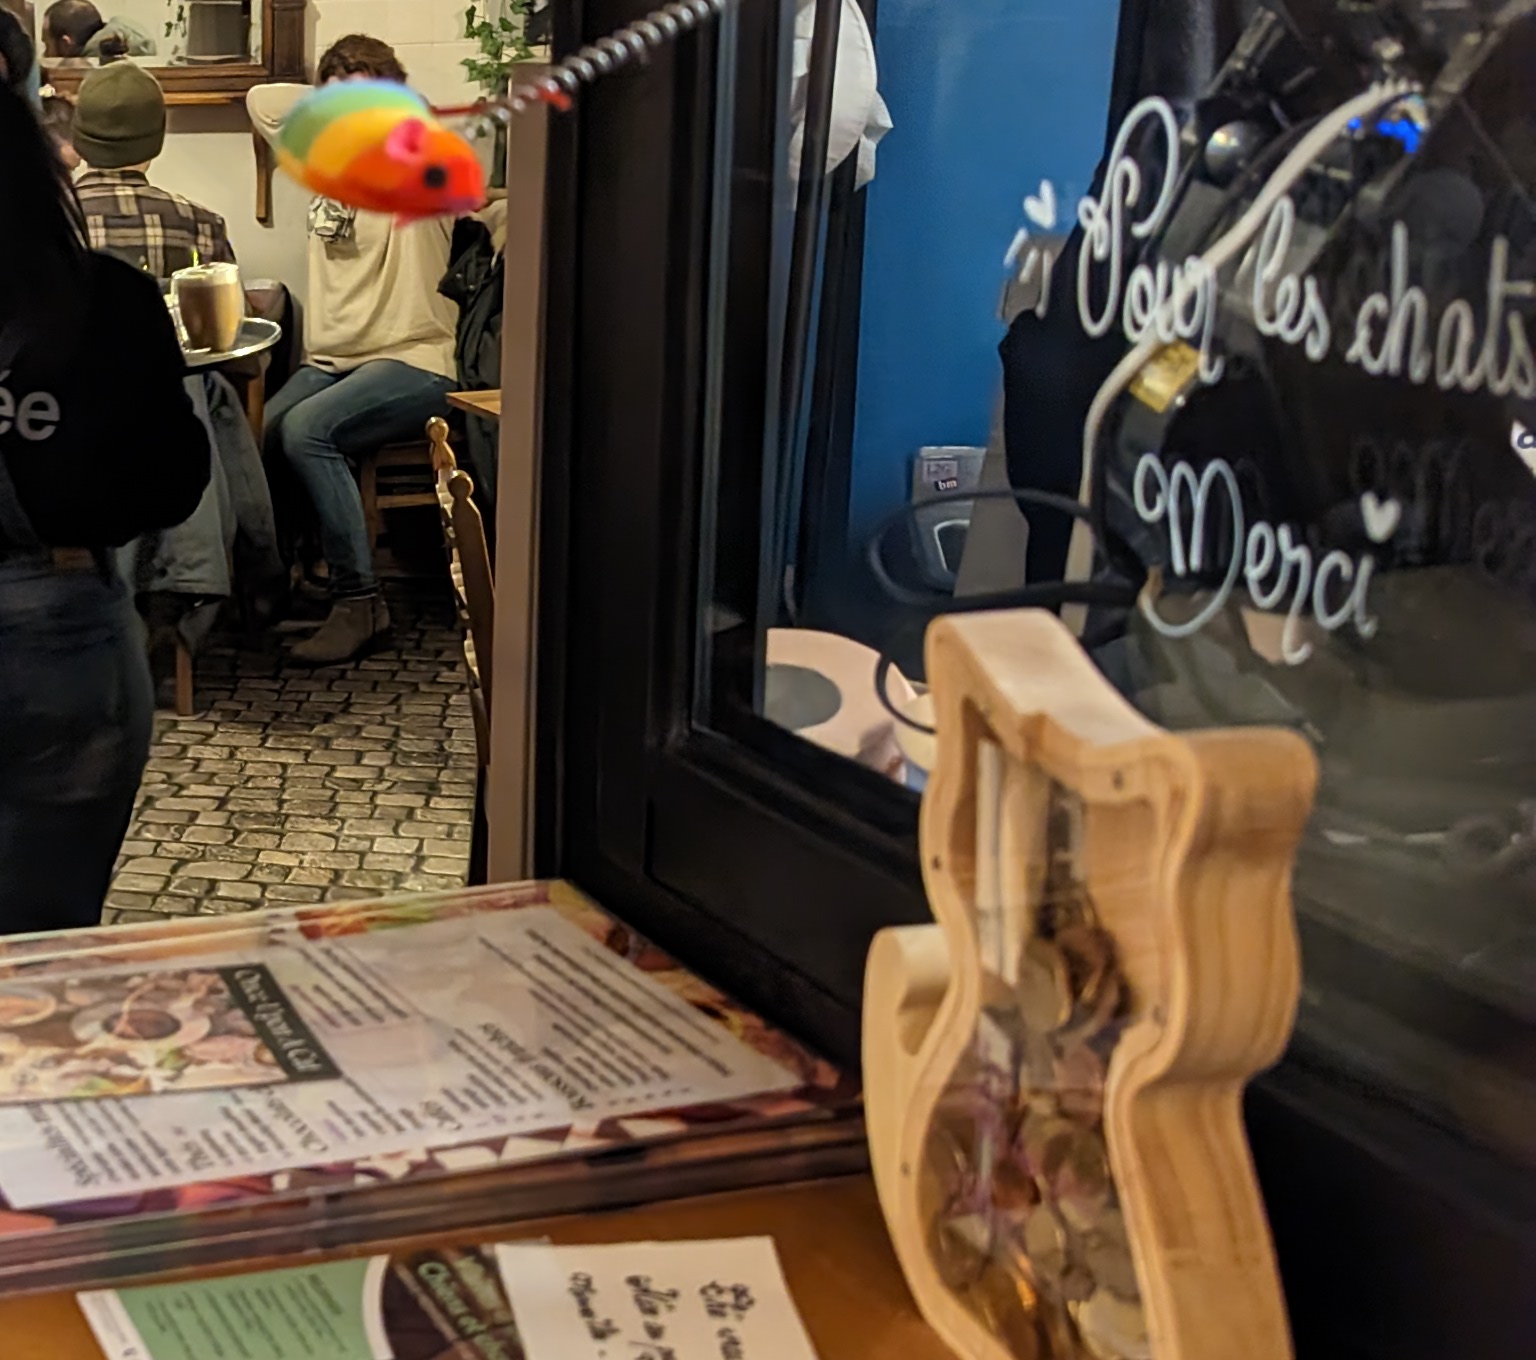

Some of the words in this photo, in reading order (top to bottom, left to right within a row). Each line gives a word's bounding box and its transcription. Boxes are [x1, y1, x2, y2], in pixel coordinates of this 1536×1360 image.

[1077, 95, 1223, 385] Pour
[1252, 195, 1331, 362] les
[1345, 220, 1536, 400] chats
[1133, 449, 1378, 666] Merci
